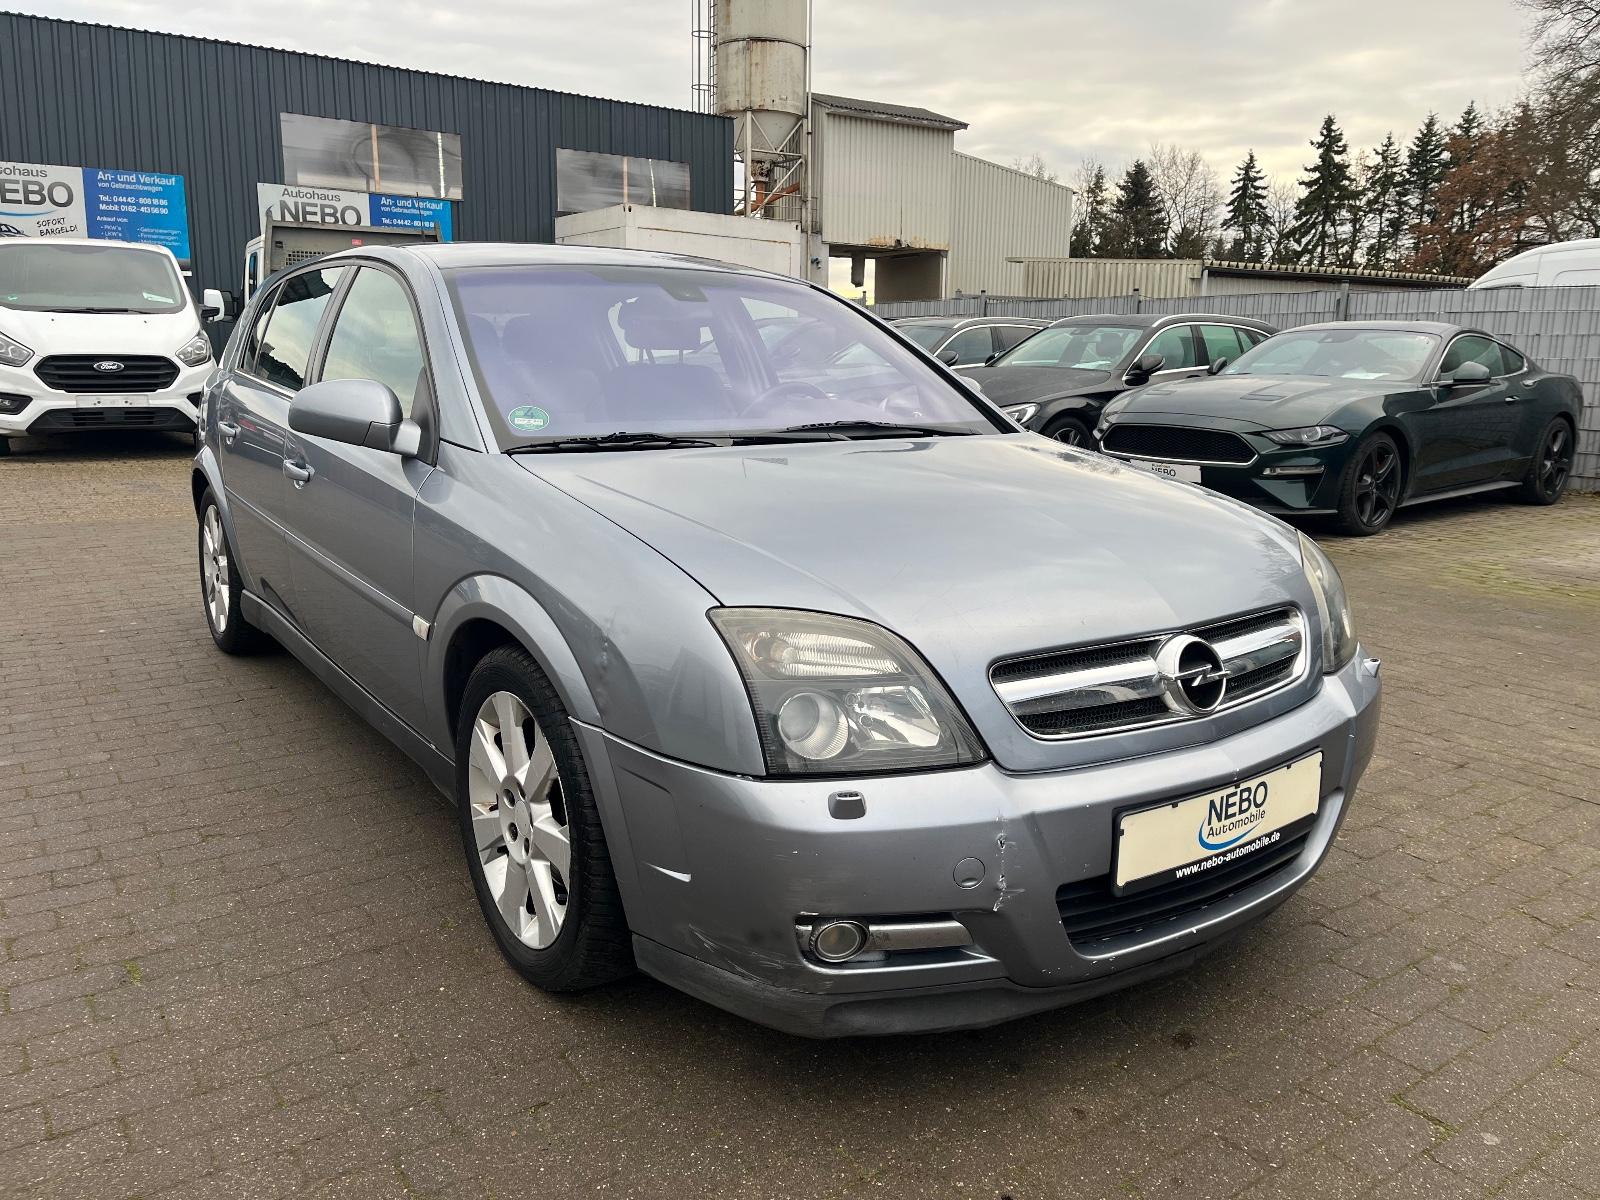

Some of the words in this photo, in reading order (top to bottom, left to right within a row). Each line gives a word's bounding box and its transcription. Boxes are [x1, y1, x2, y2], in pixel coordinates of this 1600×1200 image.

[97, 171, 115, 181] An-
[117, 174, 136, 182] und
[139, 174, 176, 186] Verkauf
[110, 182, 163, 193] Gebrauchtwagen
[282, 188, 341, 202] Autohaus
[99, 203, 119, 211] Mobil:
[380, 197, 395, 205] An-
[396, 199, 412, 207] und
[414, 200, 443, 210] Verkauf
[280, 200, 362, 225] NEBO
[36, 217, 65, 228] SOFORT
[40, 225, 78, 236] BARGELD!
[1208, 781, 1268, 826] NEBO
[1207, 809, 1266, 839] Automobile
[1176, 831, 1280, 878] www.nebo-automobile.de
